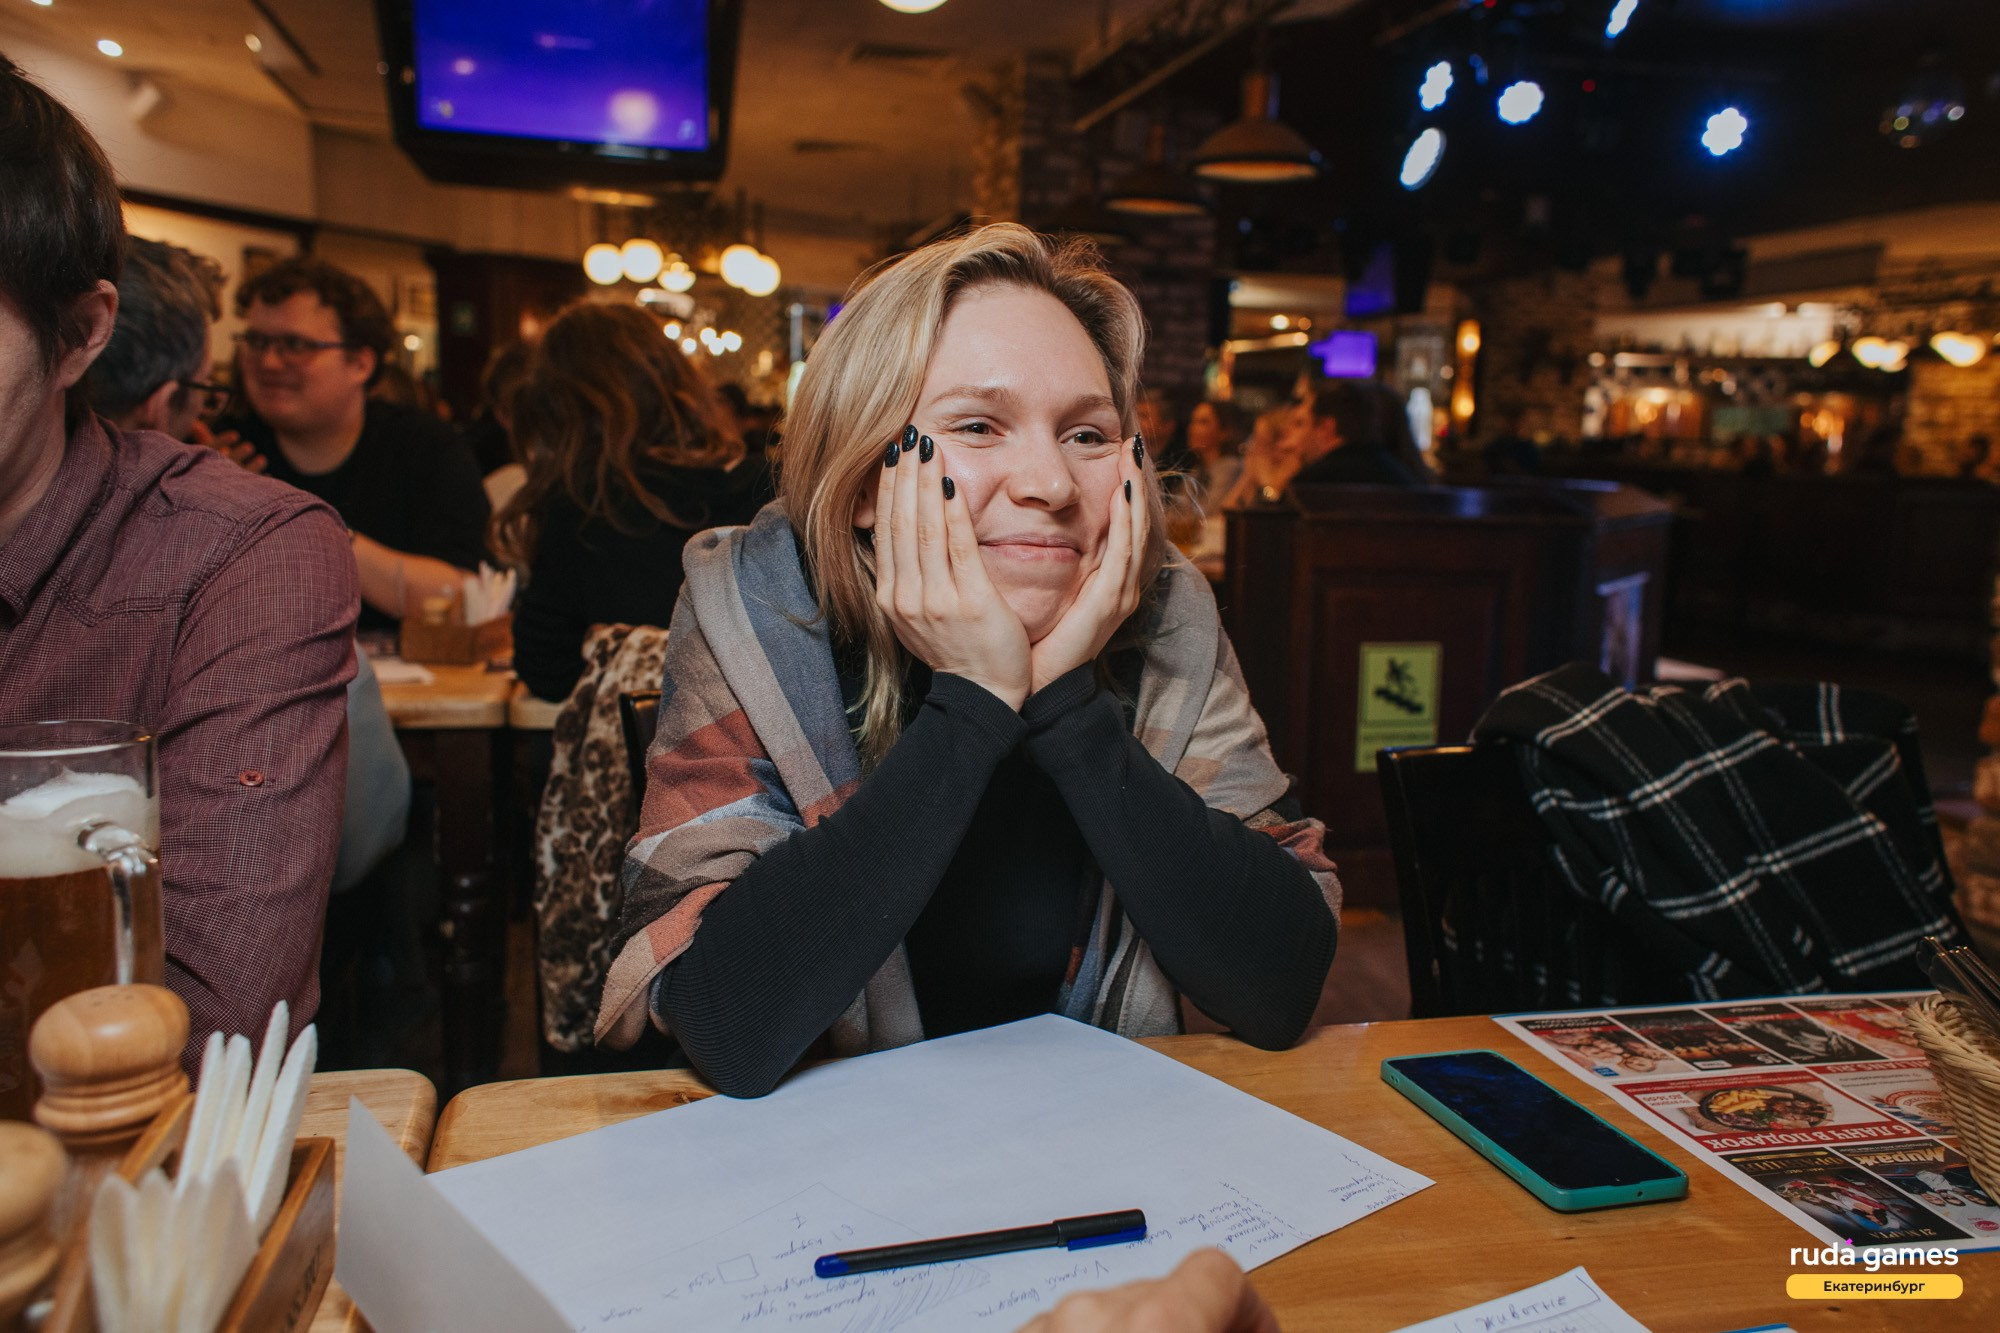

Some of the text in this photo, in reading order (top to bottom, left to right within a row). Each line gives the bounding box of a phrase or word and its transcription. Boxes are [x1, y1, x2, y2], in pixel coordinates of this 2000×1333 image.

[1702, 1125, 1911, 1149] 6 ЛАНЧ В ПОДАРОК
[1854, 1146, 1945, 1166] Мираж
[1868, 1229, 1918, 1239] МАРТА
